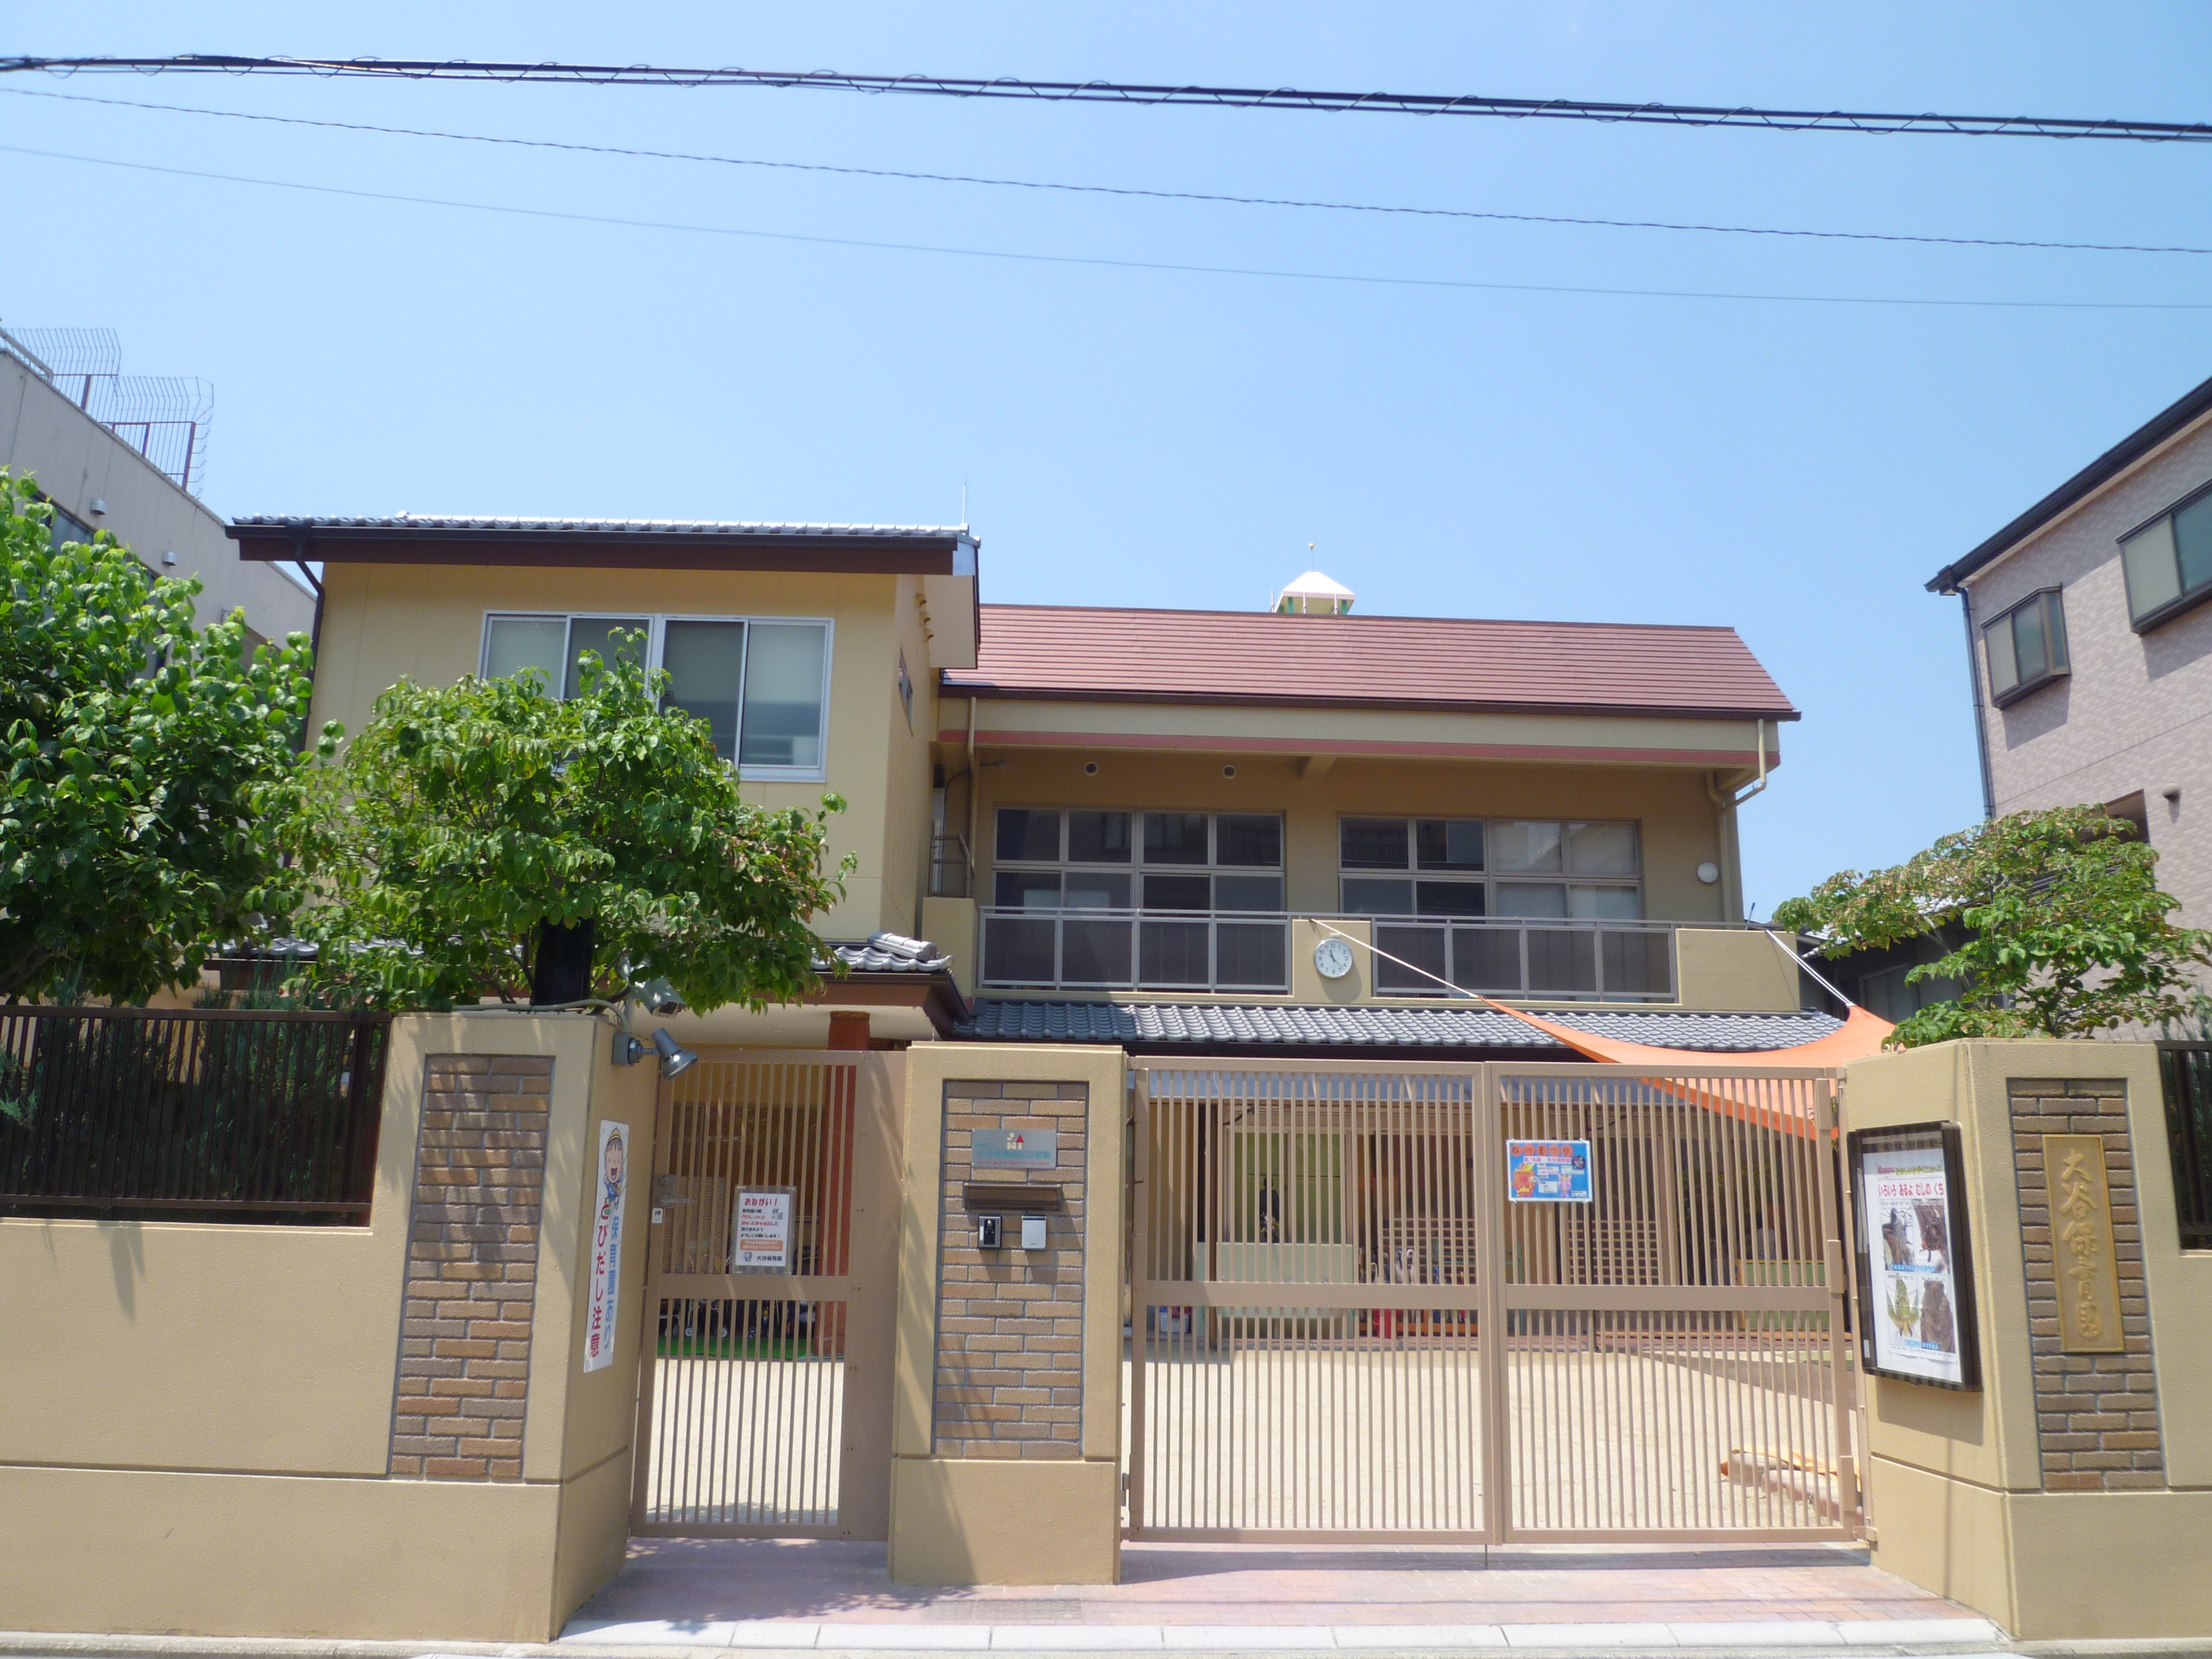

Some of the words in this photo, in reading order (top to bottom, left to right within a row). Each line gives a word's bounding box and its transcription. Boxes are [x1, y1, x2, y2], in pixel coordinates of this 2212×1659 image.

[1512, 1146, 1569, 1155] なつまつり
[1878, 1184, 1896, 1196] いろいろ
[1899, 1183, 1913, 1196] あるよ
[1916, 1182, 1931, 1196] むしの
[1934, 1181, 1944, 1196] くち
[589, 1200, 610, 1358] とびだし注意
[604, 1216, 619, 1349] 保育園あり
[2060, 1148, 2101, 1338] 大谷保育園
